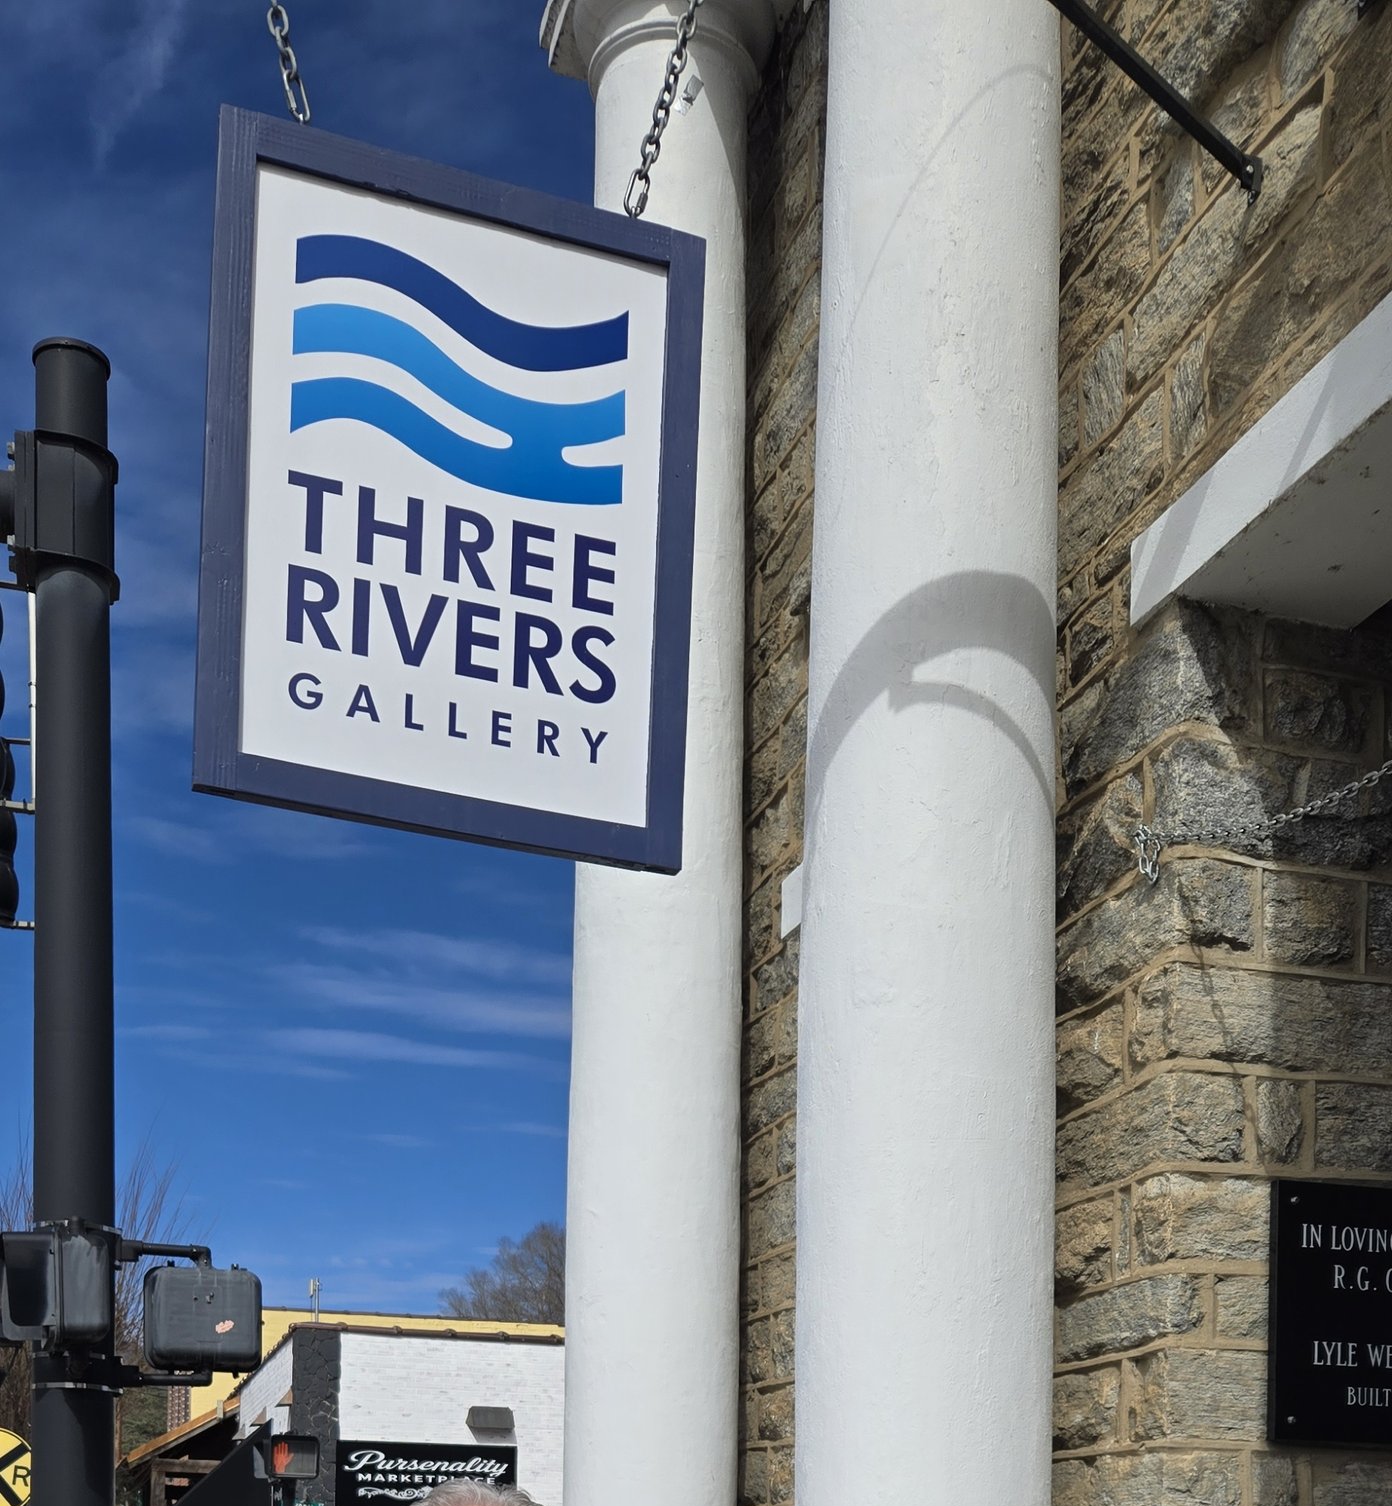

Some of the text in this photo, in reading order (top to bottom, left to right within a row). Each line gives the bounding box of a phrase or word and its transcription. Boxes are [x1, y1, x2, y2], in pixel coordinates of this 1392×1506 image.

[287, 469, 617, 617] THREE
[285, 563, 617, 704] RIVERS
[287, 672, 609, 765] GALLERY
[1301, 1223, 1392, 1253] IN LOVIN
[1313, 1340, 1358, 1367] LYLE
[1347, 1386, 1392, 1407] BUILT
[12, 1465, 29, 1487] R
[344, 1450, 509, 1477] Pursenality
